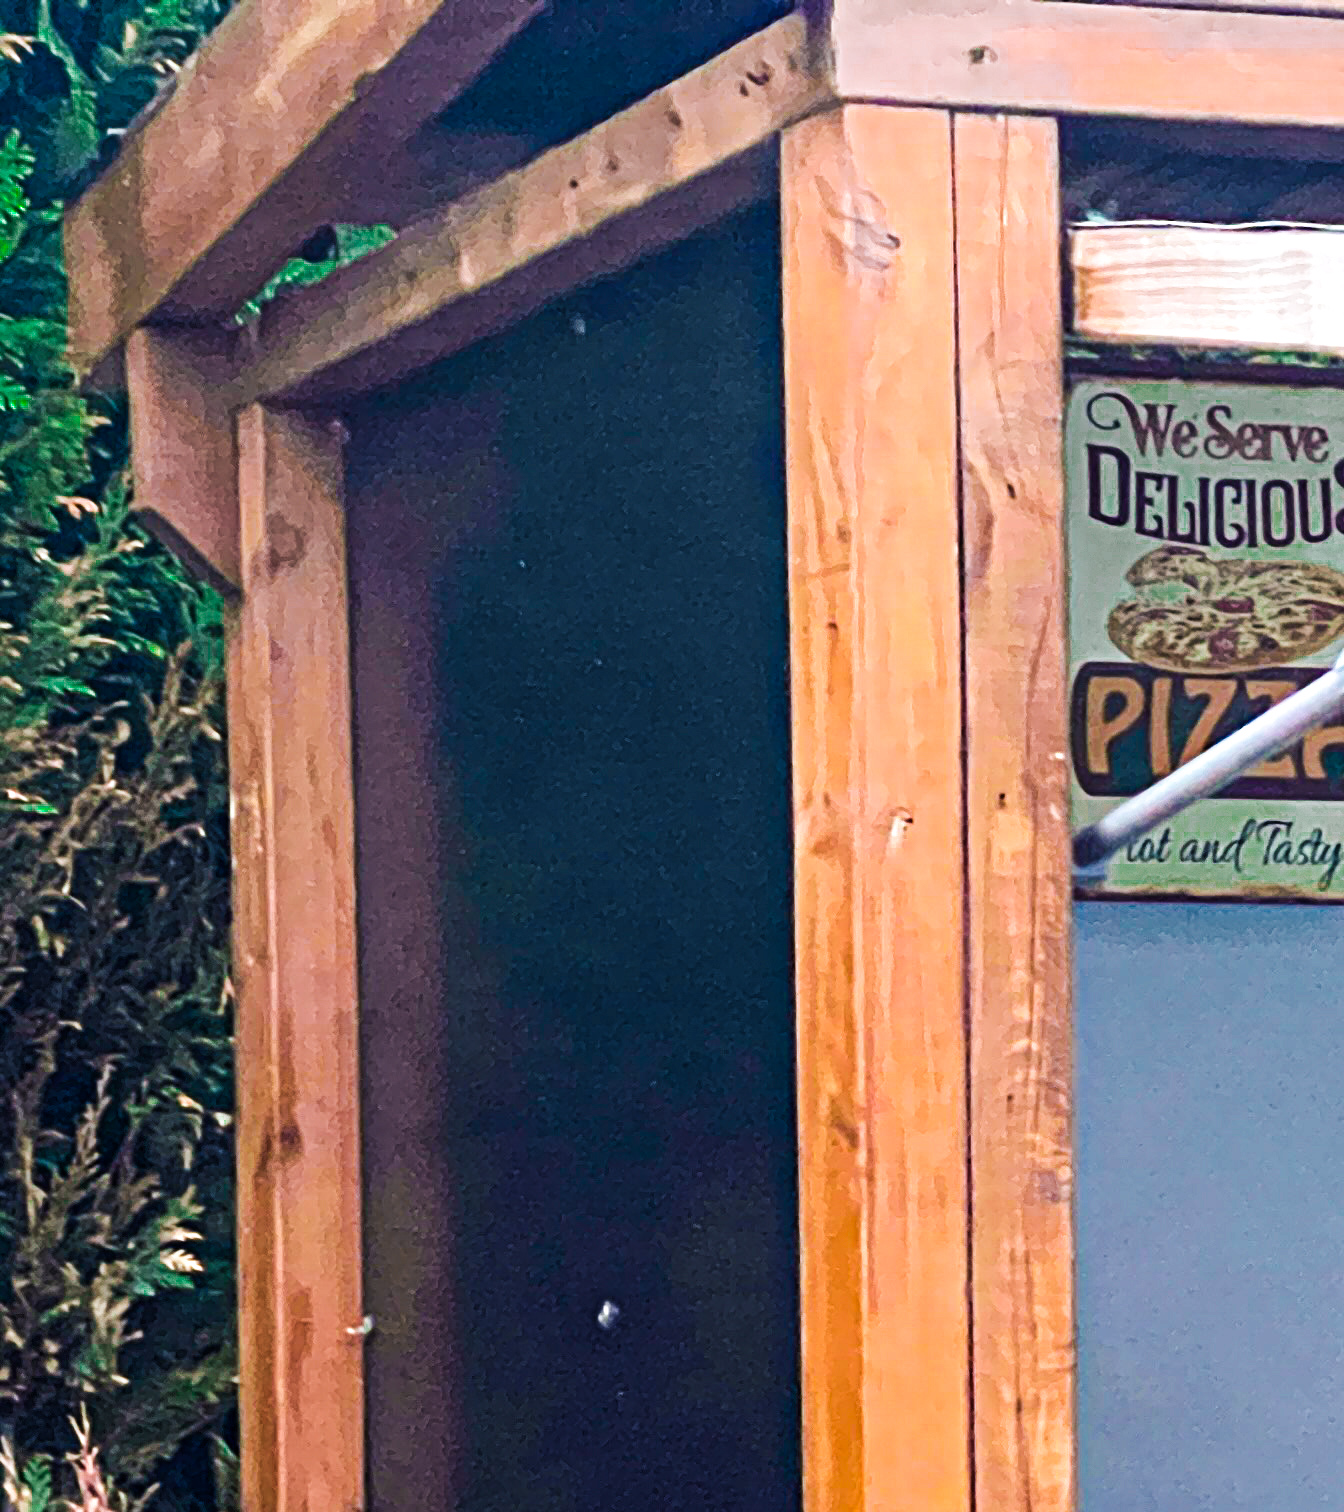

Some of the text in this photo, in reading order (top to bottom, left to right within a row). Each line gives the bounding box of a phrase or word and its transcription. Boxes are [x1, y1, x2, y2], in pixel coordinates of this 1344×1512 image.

[1086, 391, 1330, 463] We Serve
[1179, 818, 1256, 873] and
